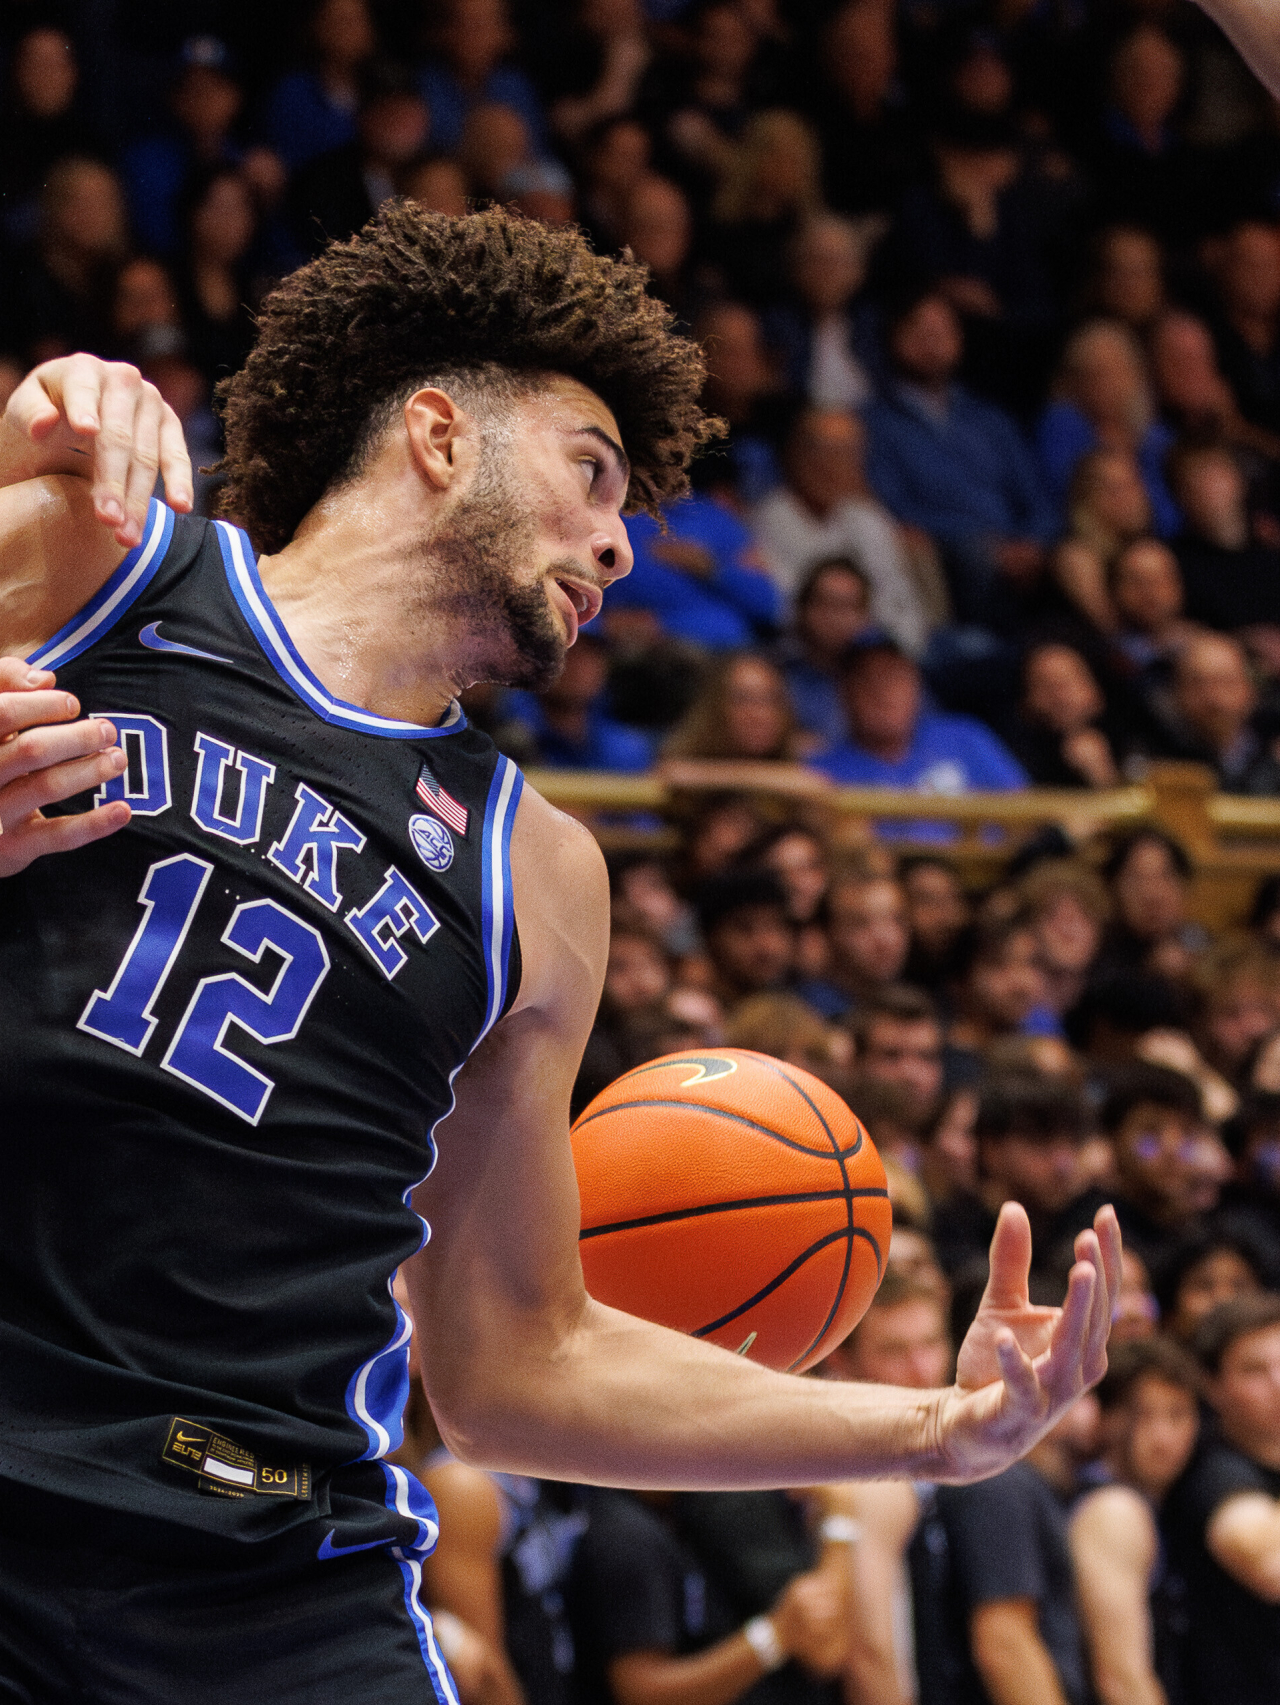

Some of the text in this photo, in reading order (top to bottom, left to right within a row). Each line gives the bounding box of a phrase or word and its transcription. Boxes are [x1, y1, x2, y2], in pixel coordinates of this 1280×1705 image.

[88, 712, 441, 981] DUKE
[75, 852, 332, 1127] 12
[171, 1441, 203, 1461] ELITE
[261, 1467, 288, 1484] 50
